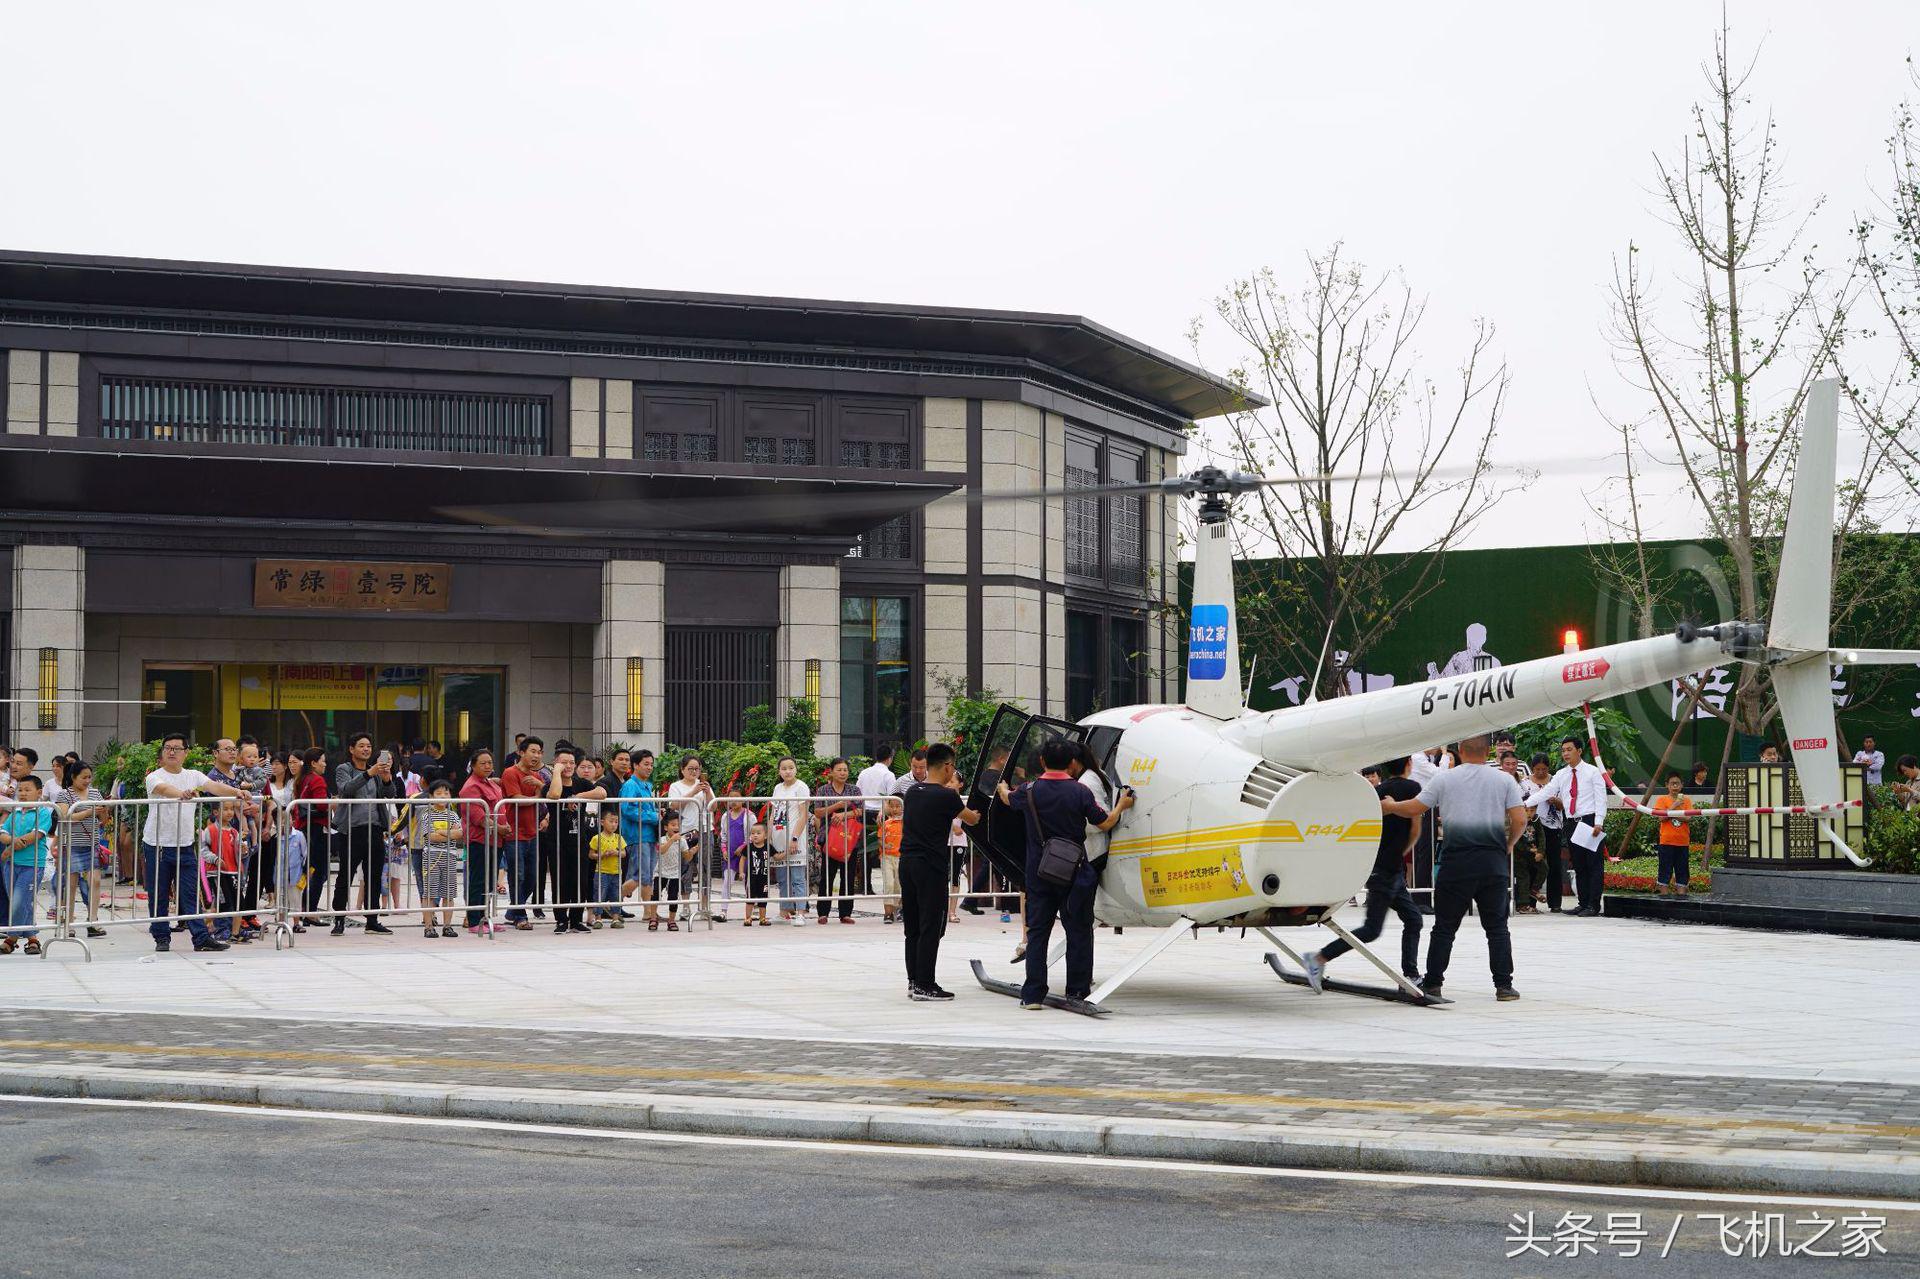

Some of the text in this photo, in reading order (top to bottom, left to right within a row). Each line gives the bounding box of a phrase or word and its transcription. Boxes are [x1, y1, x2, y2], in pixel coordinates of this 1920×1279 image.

[1421, 669, 1518, 716] B-70AN
[1795, 739, 1825, 750] DANGER
[1131, 757, 1158, 773] R44
[1304, 823, 1345, 836] R44
